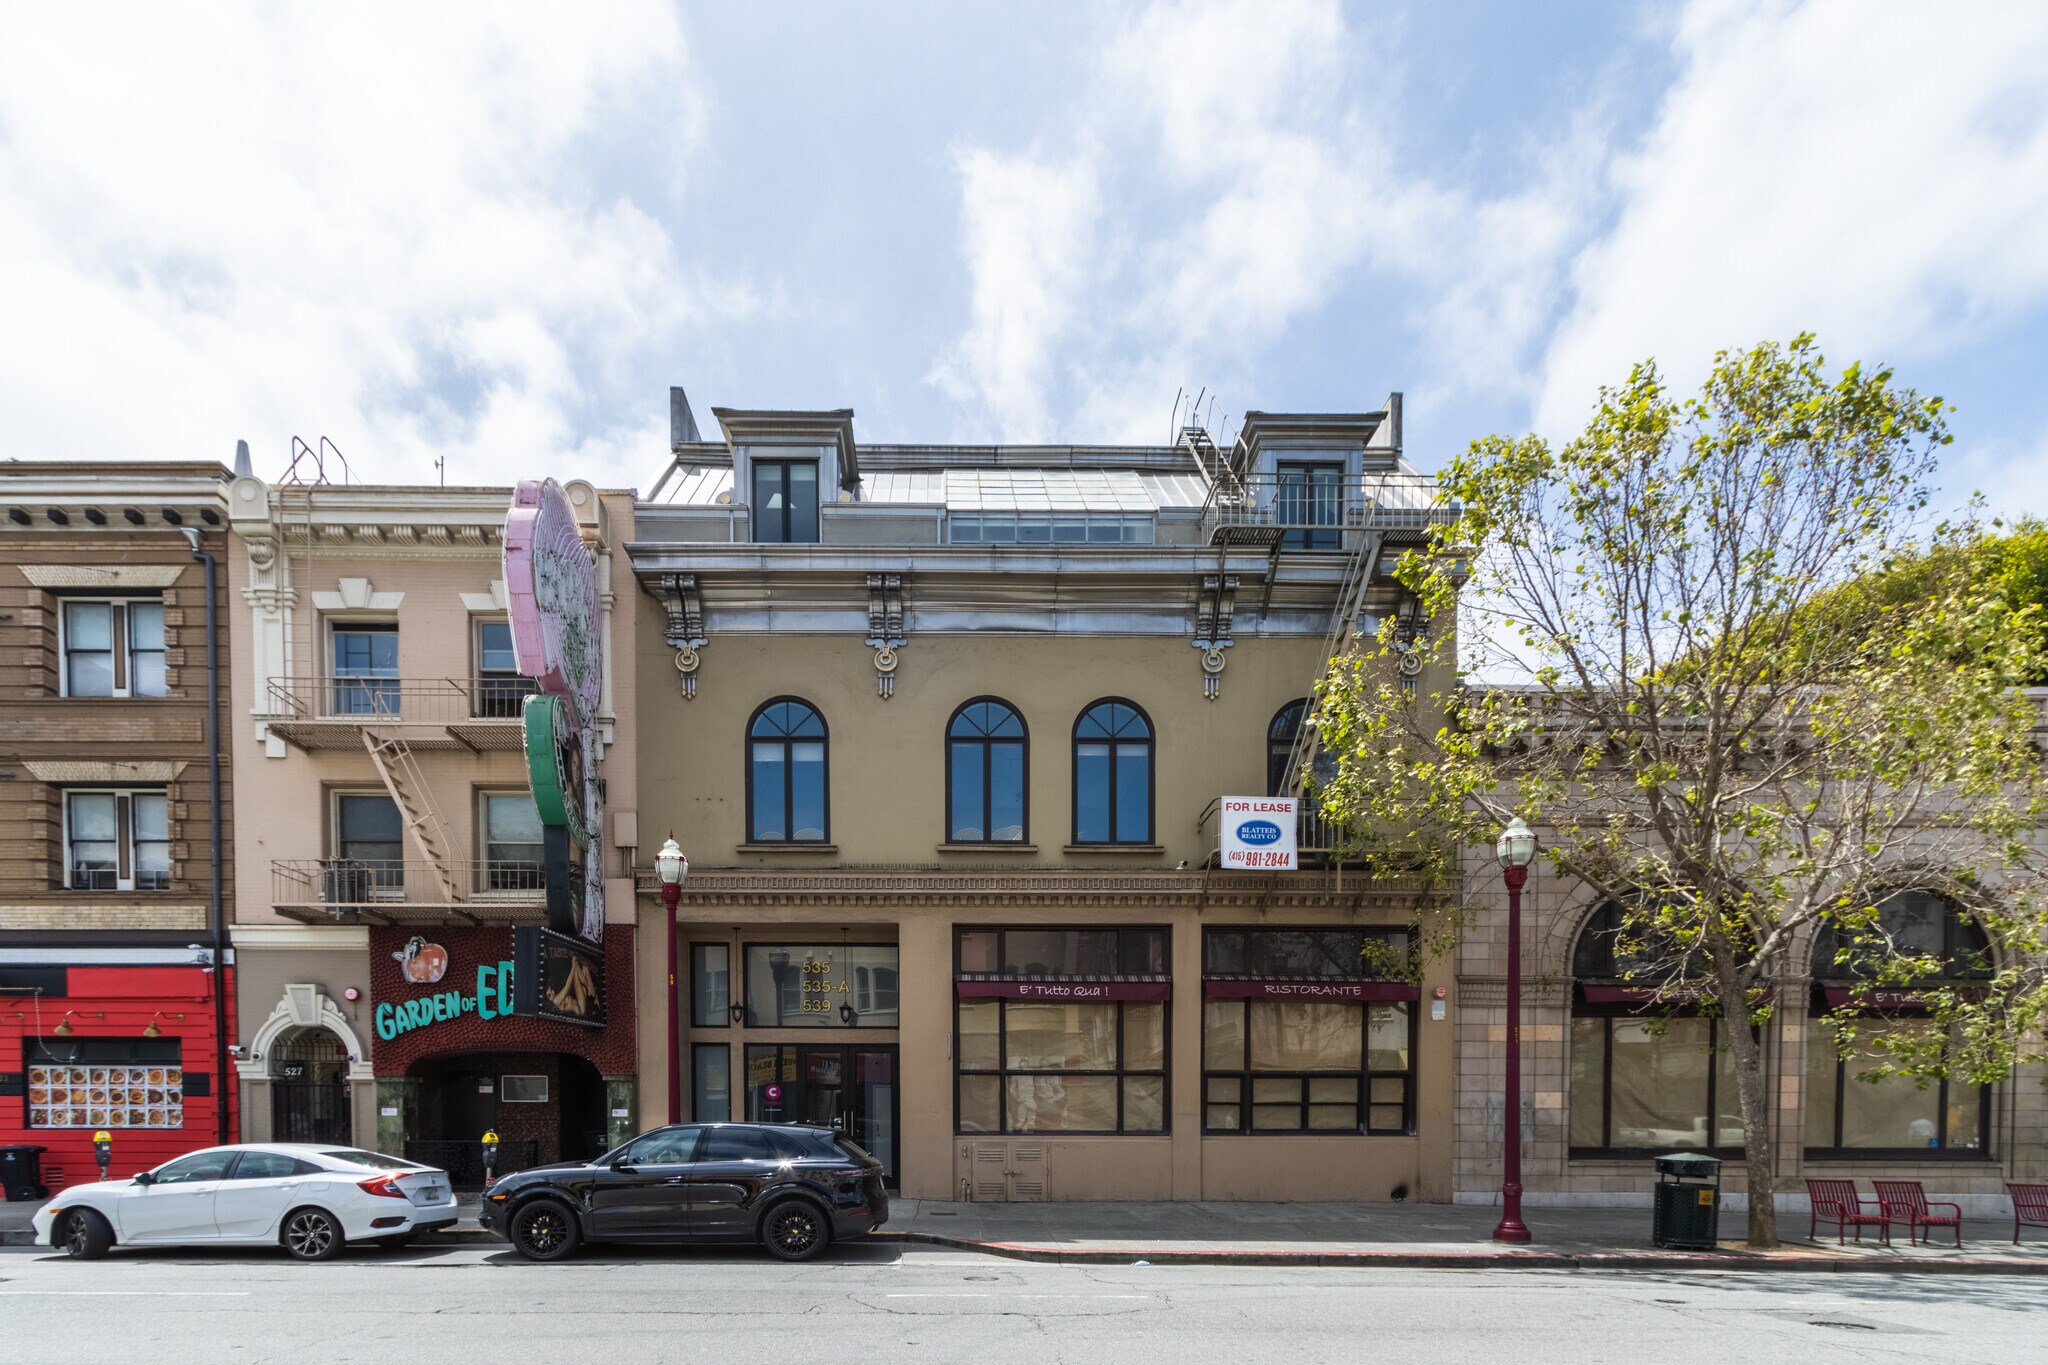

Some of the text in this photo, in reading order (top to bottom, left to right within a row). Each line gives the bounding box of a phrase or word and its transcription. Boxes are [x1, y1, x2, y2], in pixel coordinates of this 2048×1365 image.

[1225, 802, 1292, 813] FOR LEASE
[1245, 852, 1290, 867] 981-2844
[802, 961, 831, 974] 535
[802, 980, 851, 993] 535-A
[1035, 985, 1071, 996] Tutto
[1073, 986, 1101, 997] Qua
[1264, 985, 1362, 996] RISTORANTE
[376, 990, 462, 1041] GARDEN
[461, 996, 478, 1013] OF
[477, 961, 515, 1020] ED
[802, 999, 832, 1012] 539
[284, 1066, 304, 1076] 527
